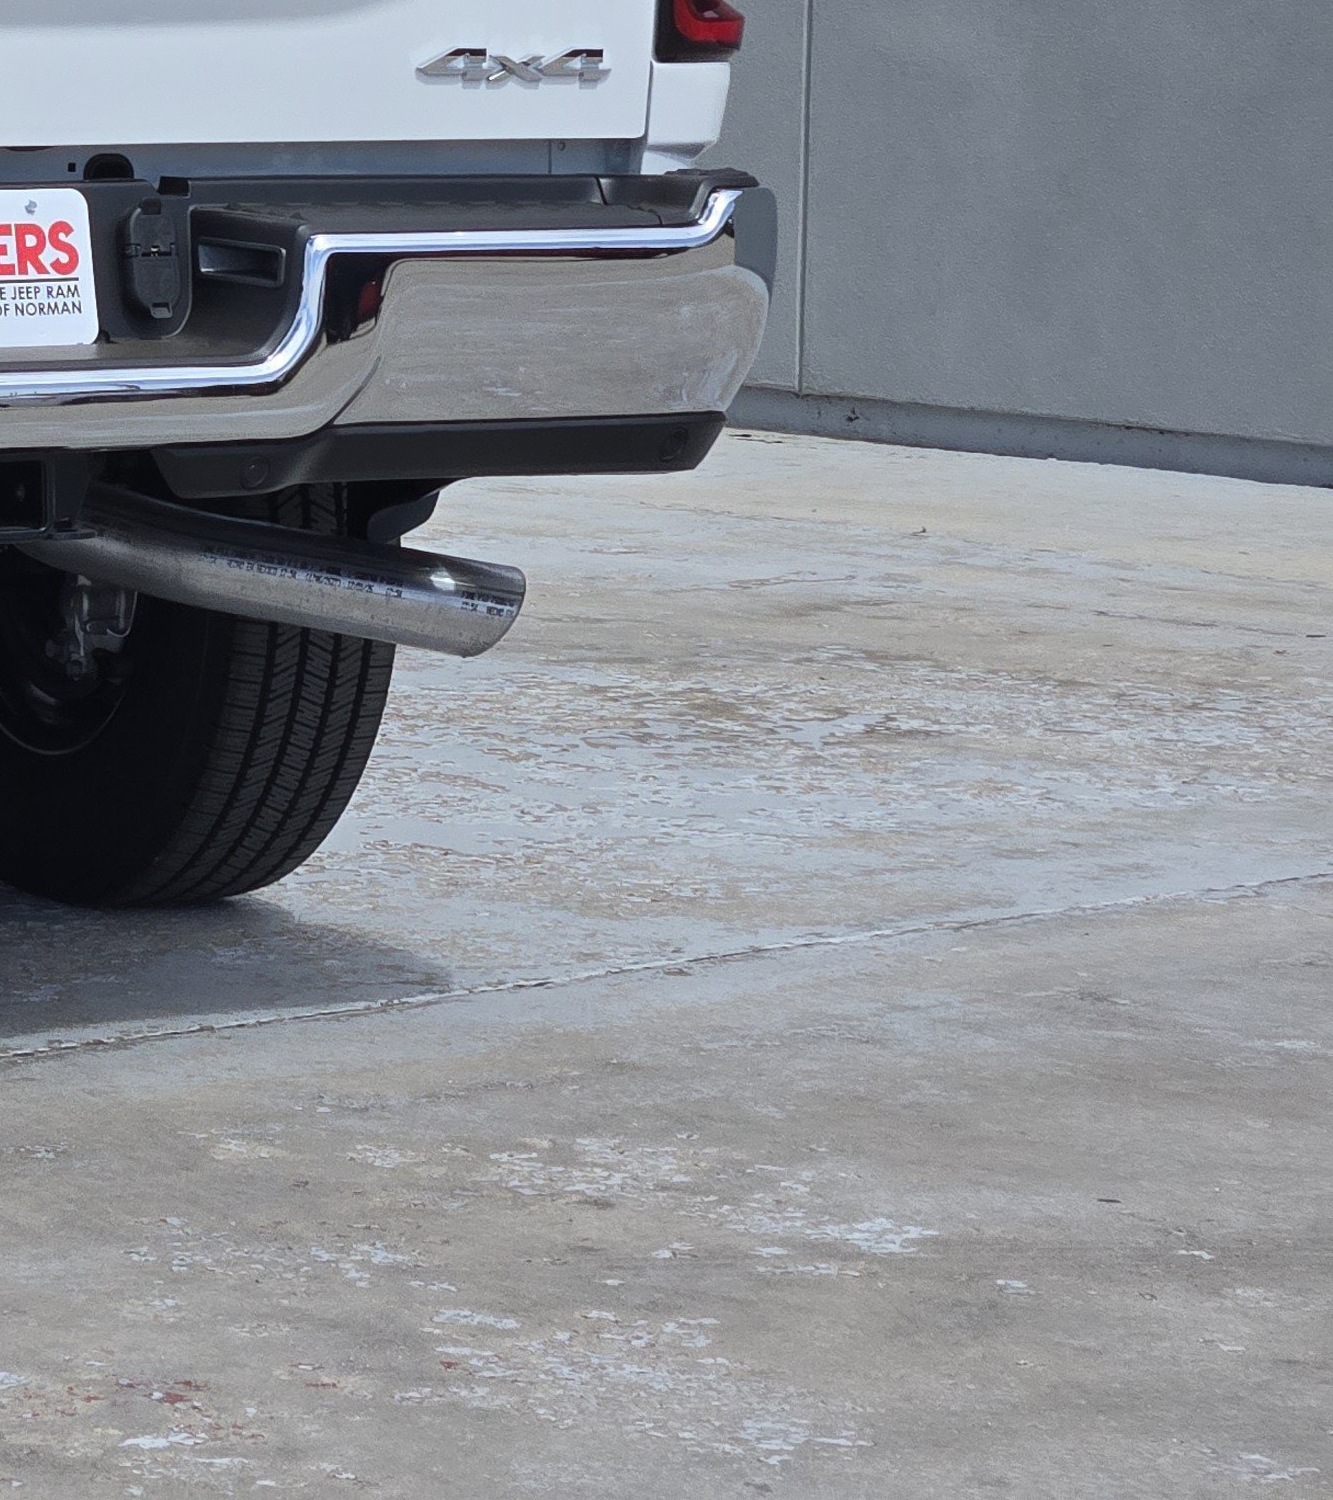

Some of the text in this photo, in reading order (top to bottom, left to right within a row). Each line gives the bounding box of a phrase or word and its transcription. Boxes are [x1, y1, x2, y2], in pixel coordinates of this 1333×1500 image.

[10, 285, 41, 301] JEEP
[47, 284, 81, 300] RAM
[14, 301, 83, 317] NORMAN
